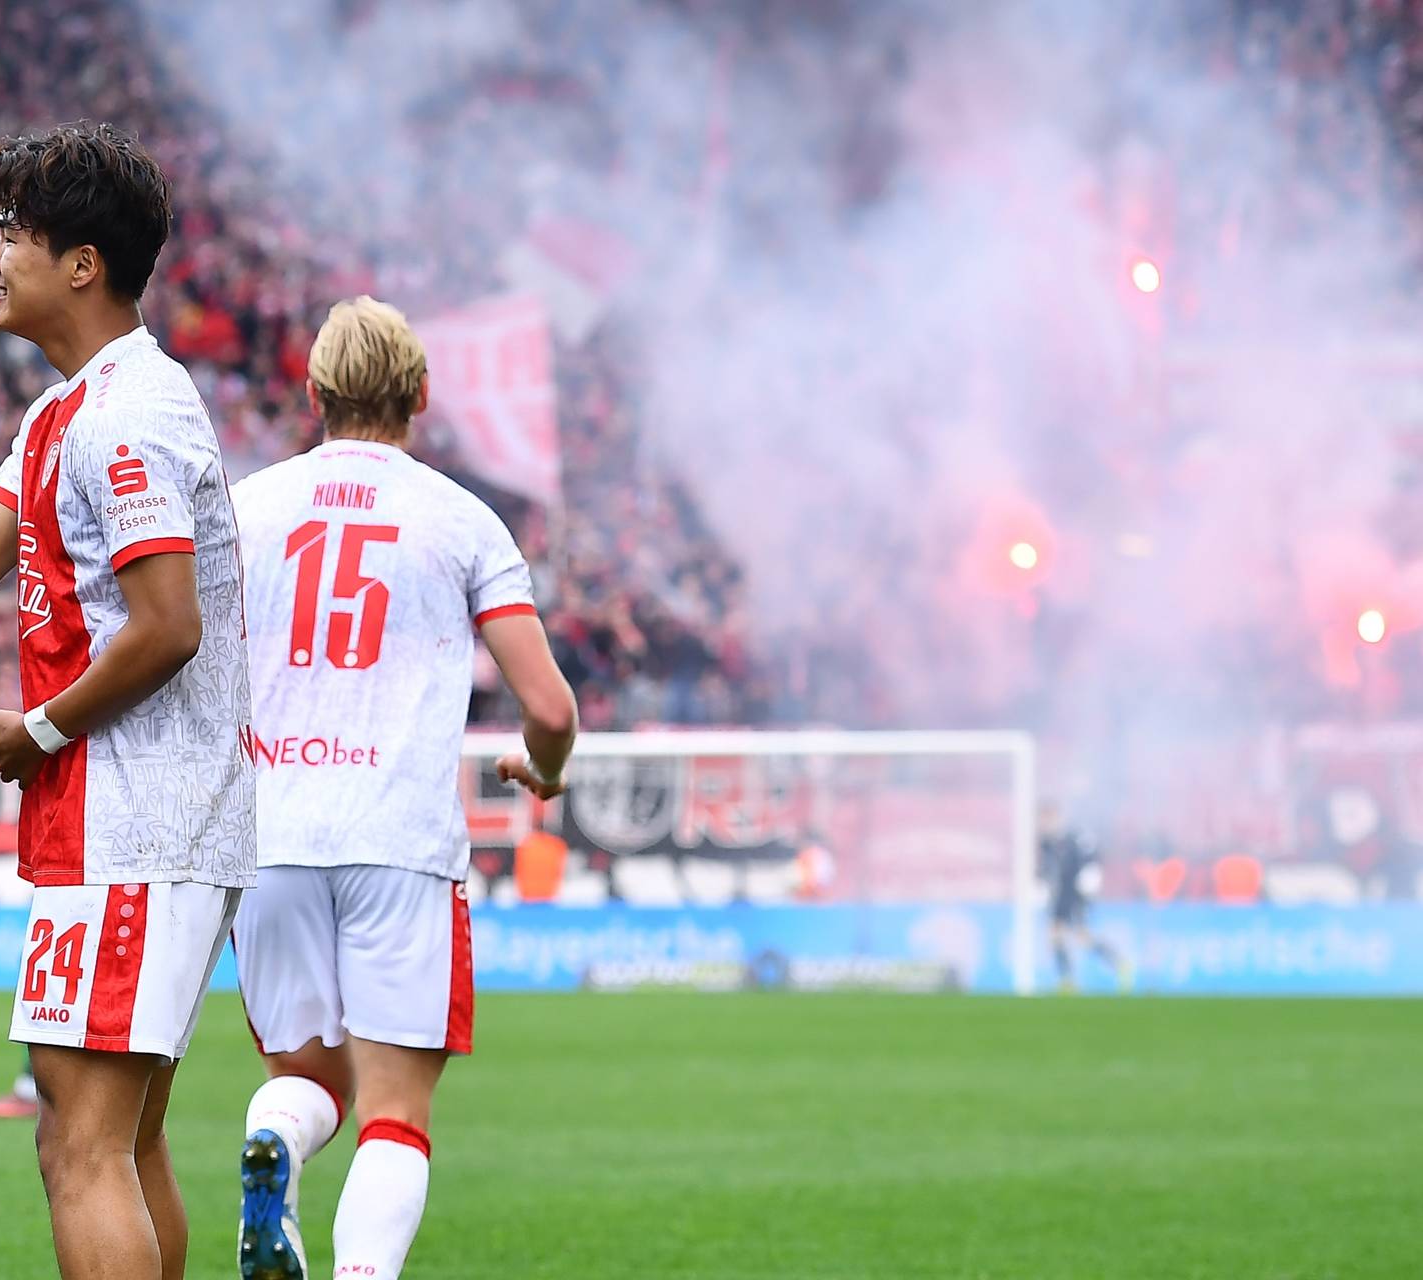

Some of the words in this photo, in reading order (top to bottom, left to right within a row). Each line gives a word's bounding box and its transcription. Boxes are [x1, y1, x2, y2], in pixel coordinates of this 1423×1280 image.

[106, 495, 167, 521] Sparkasse
[119, 513, 157, 532] Essen
[284, 520, 400, 670] 15
[22, 918, 88, 1005] 24
[31, 1006, 70, 1023] JAKO
